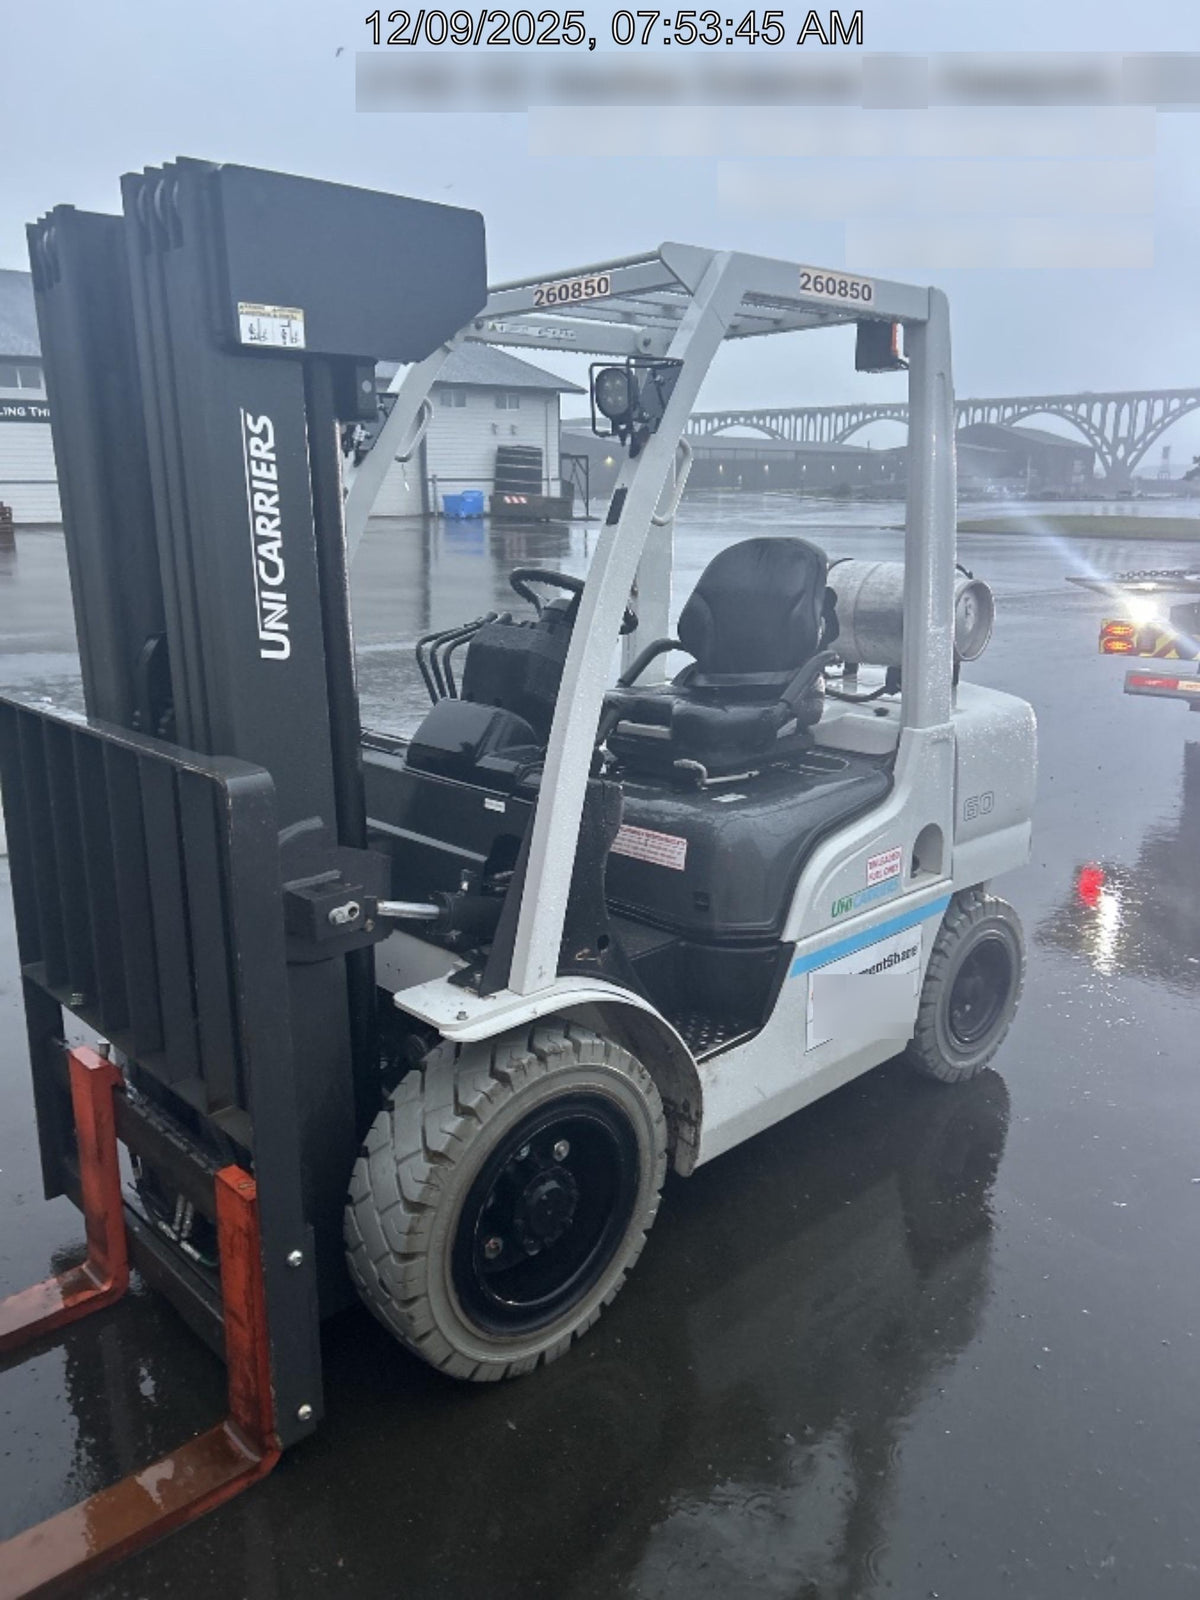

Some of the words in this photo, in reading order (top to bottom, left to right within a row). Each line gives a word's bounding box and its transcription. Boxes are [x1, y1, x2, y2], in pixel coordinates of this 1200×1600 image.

[533, 276, 609, 307] 260850
[799, 271, 872, 302] 260850
[245, 412, 291, 661] UNICARRIERS
[963, 790, 994, 822] 60
